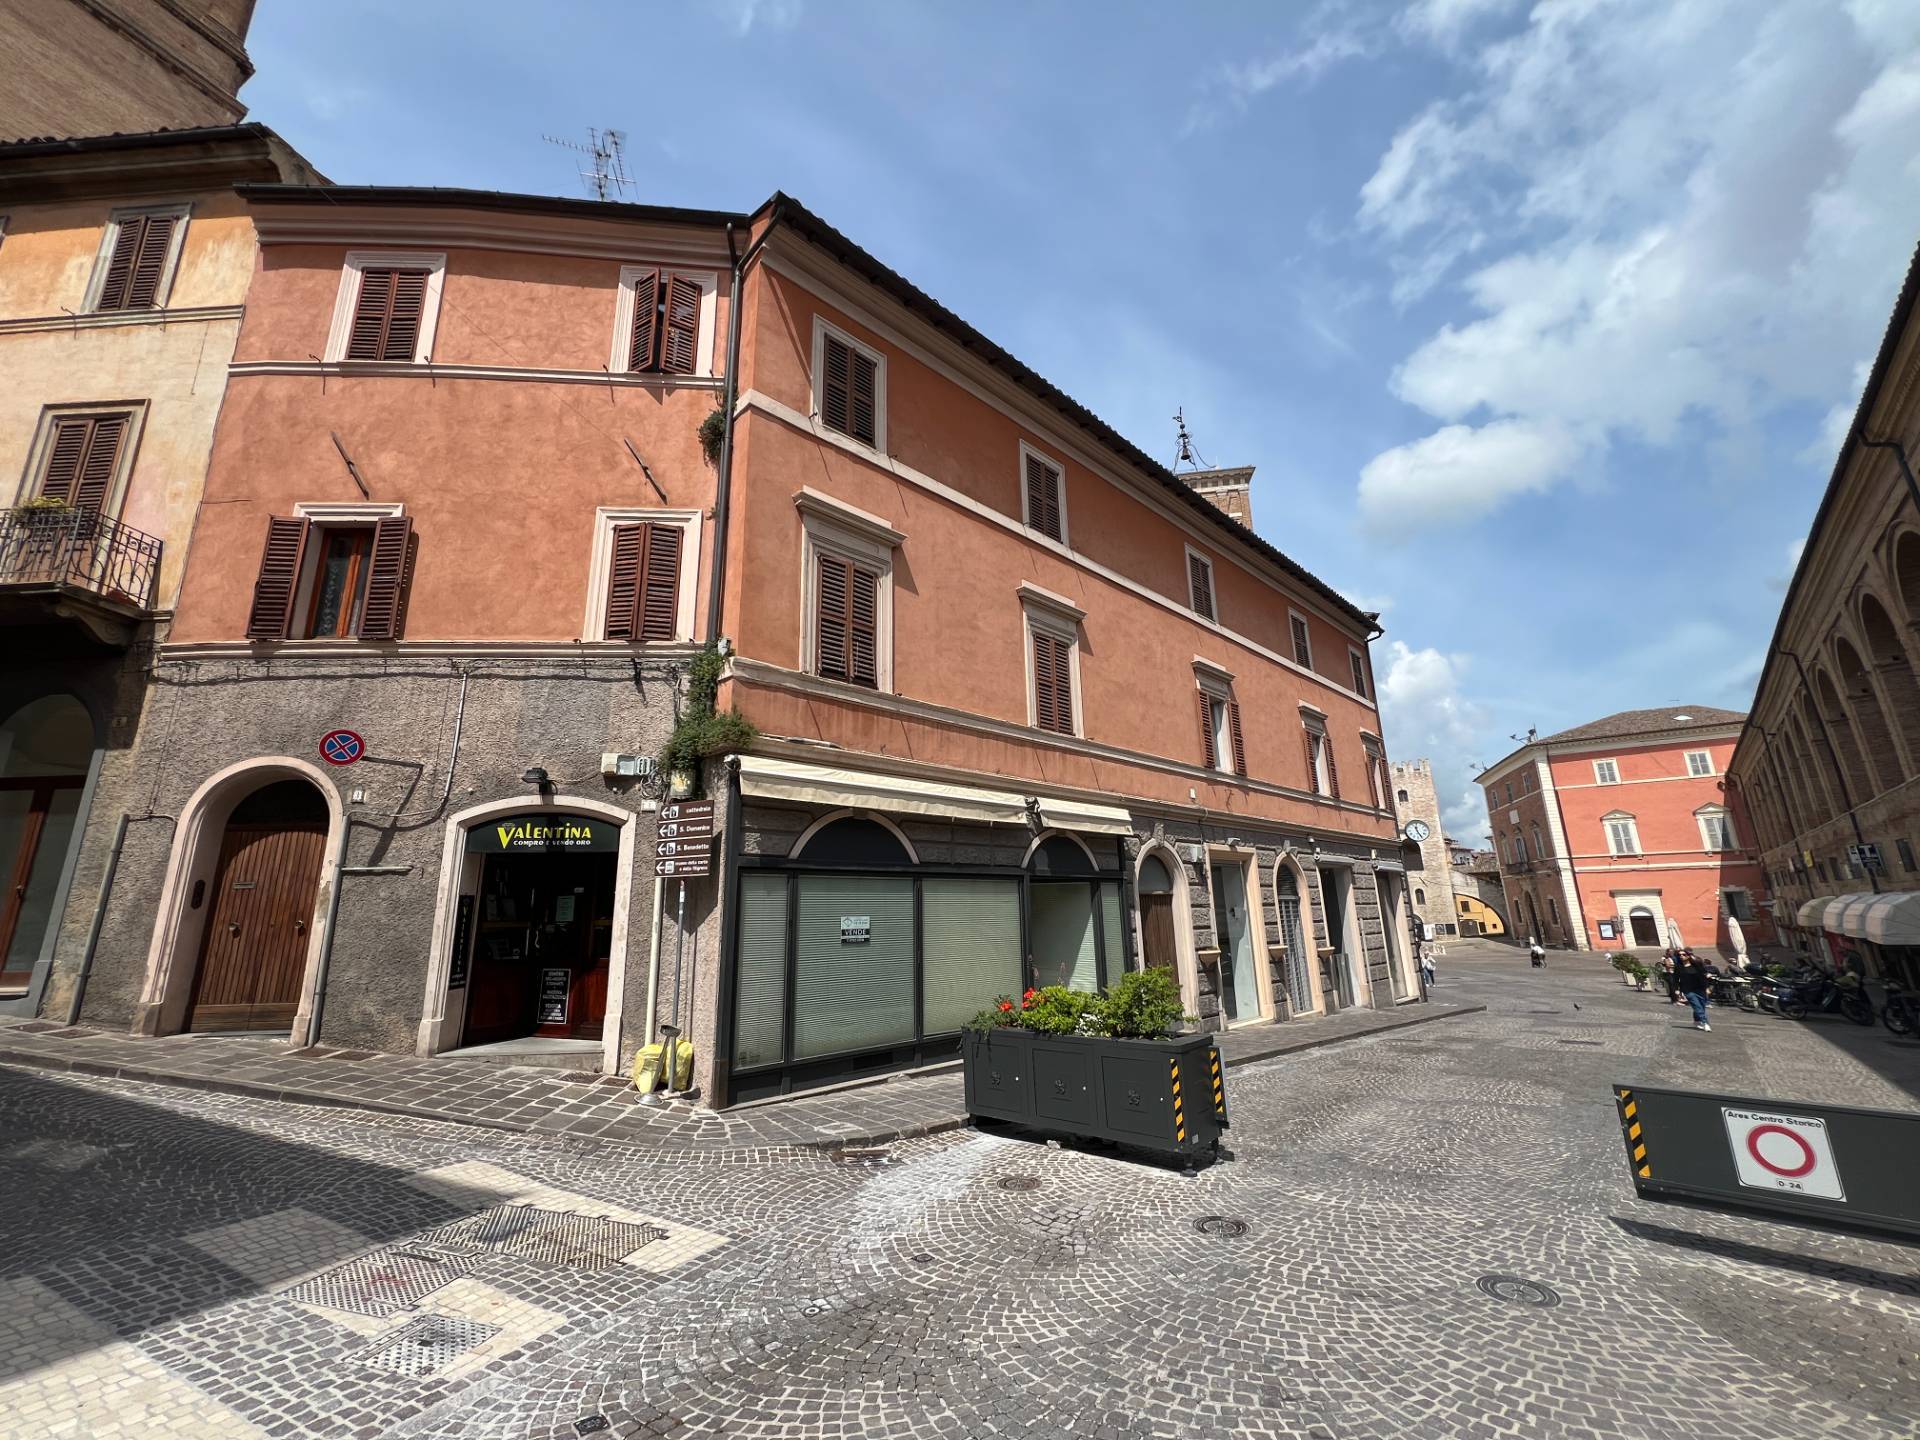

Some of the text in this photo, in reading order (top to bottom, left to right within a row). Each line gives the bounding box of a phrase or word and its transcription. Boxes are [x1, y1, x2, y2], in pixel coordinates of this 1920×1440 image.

[1727, 1111, 1821, 1128] Area Centro Storico
